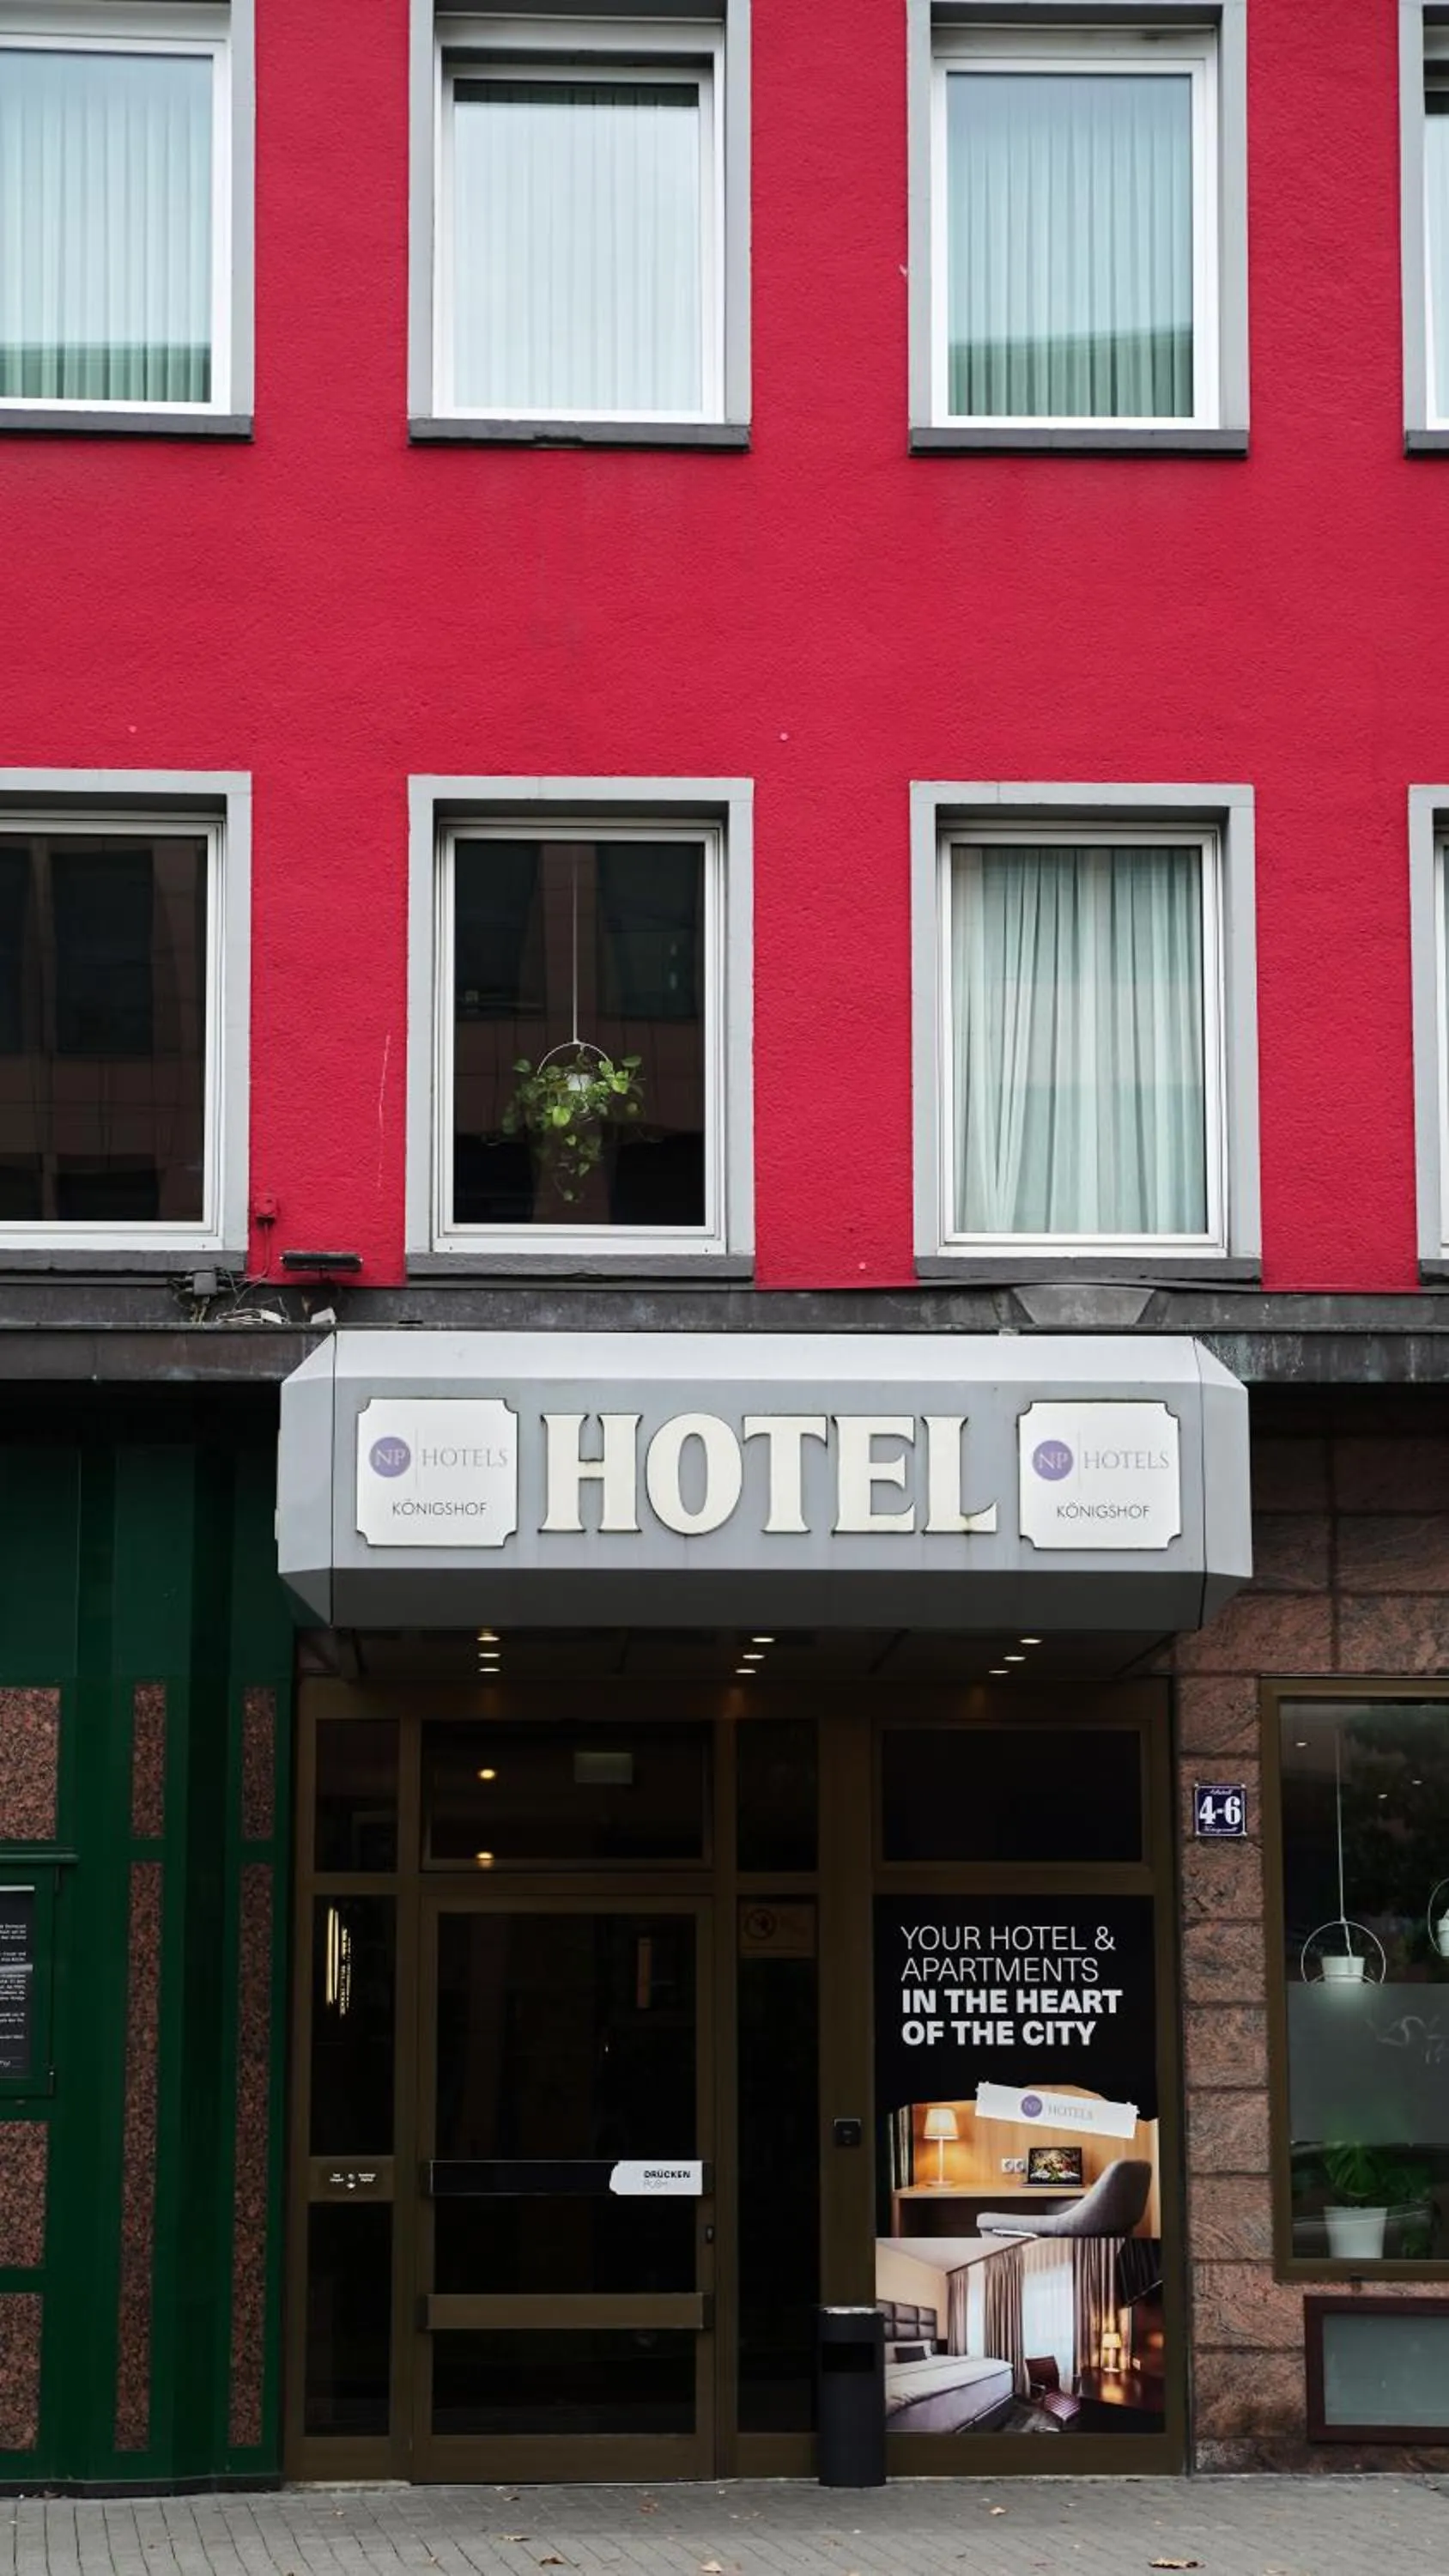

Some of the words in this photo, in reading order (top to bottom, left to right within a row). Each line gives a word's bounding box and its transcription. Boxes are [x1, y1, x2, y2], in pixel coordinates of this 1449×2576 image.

[374, 1449, 406, 1467] NP
[422, 1447, 508, 1467] HOTELS
[1038, 1451, 1069, 1470] NP
[1084, 1449, 1170, 1469] HOTELS
[538, 1413, 997, 1535] HOTEL
[392, 1498, 488, 1516] KÖNIGSHOF
[1057, 1502, 1151, 1519] KÖNIGSHOF
[1199, 1795, 1241, 1825] 4-6
[900, 1925, 981, 1950] YOUR
[991, 1925, 1087, 1950] HOTEL
[1094, 1925, 1116, 1951] &
[900, 1957, 1100, 1983] APARTMENTS
[902, 1989, 937, 2014] IN
[944, 1989, 1008, 2014] THE
[1016, 1989, 1123, 2014] HEART
[901, 2020, 944, 2045] OF
[950, 2020, 1015, 2045] THE
[1022, 2020, 1097, 2045] CITY
